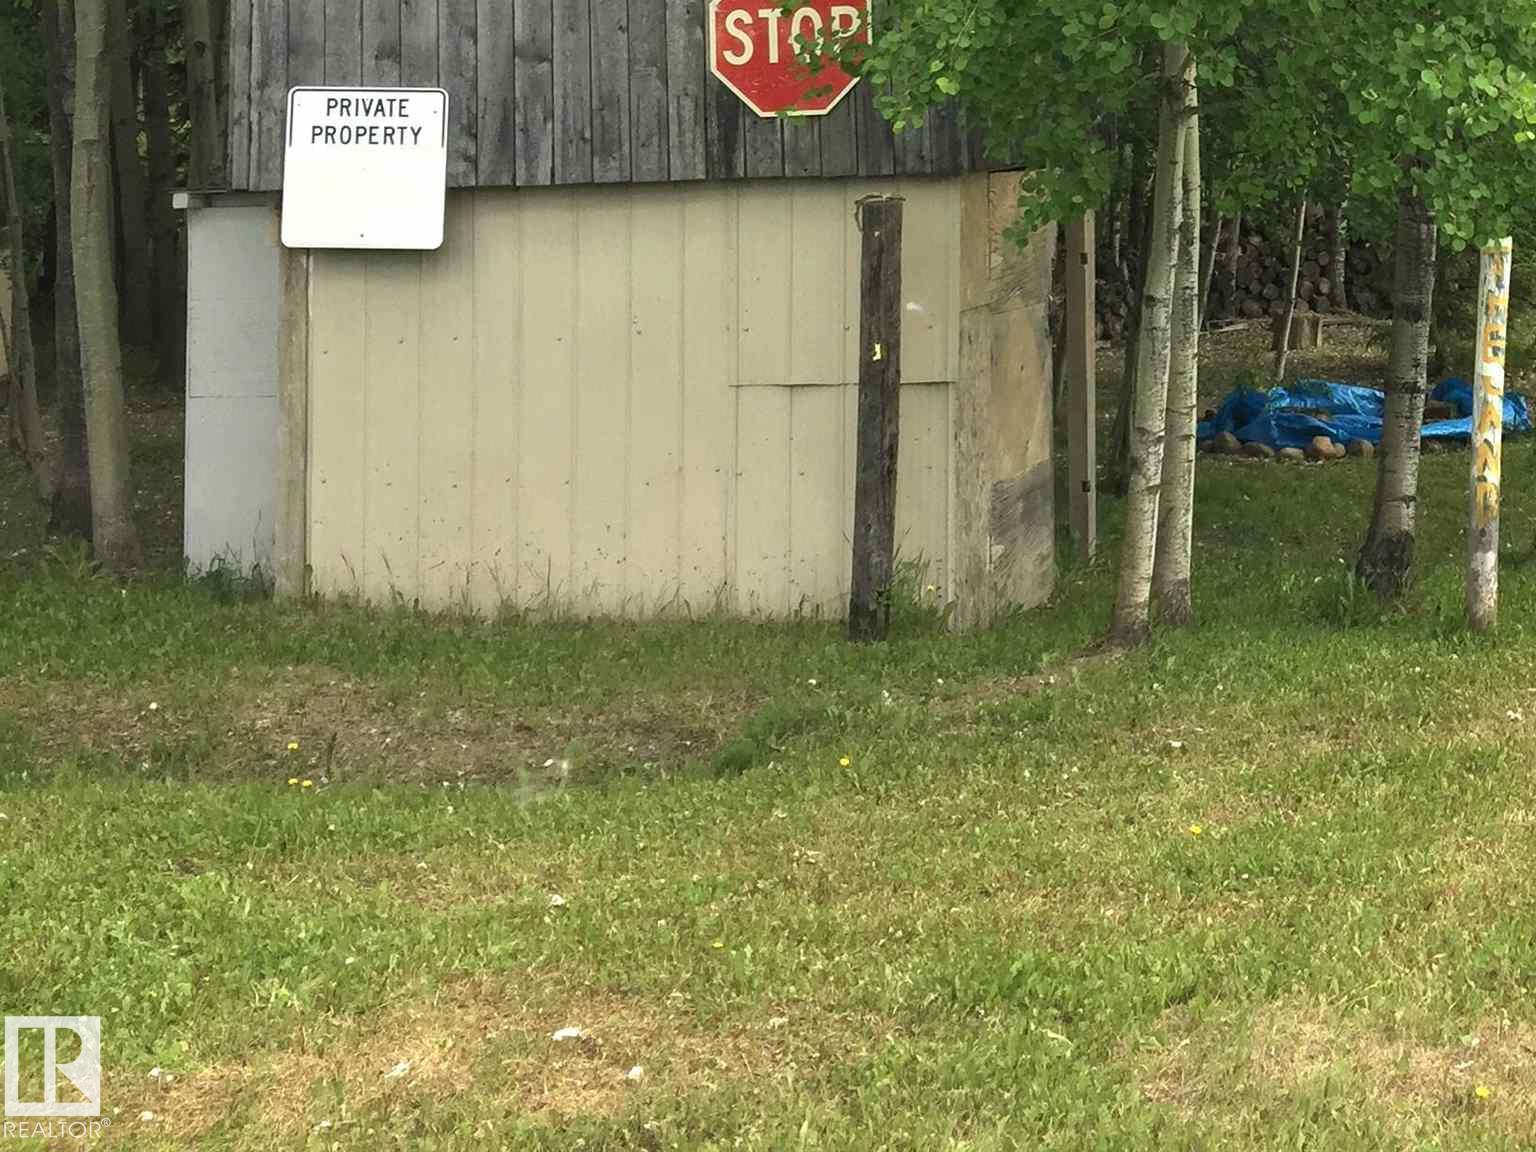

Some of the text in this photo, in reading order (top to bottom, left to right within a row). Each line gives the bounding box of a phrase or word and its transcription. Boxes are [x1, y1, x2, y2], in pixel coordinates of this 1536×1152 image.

[722, 6, 862, 66] STOP
[326, 97, 409, 118] PRIVATE
[311, 125, 422, 145] PROPERTY
